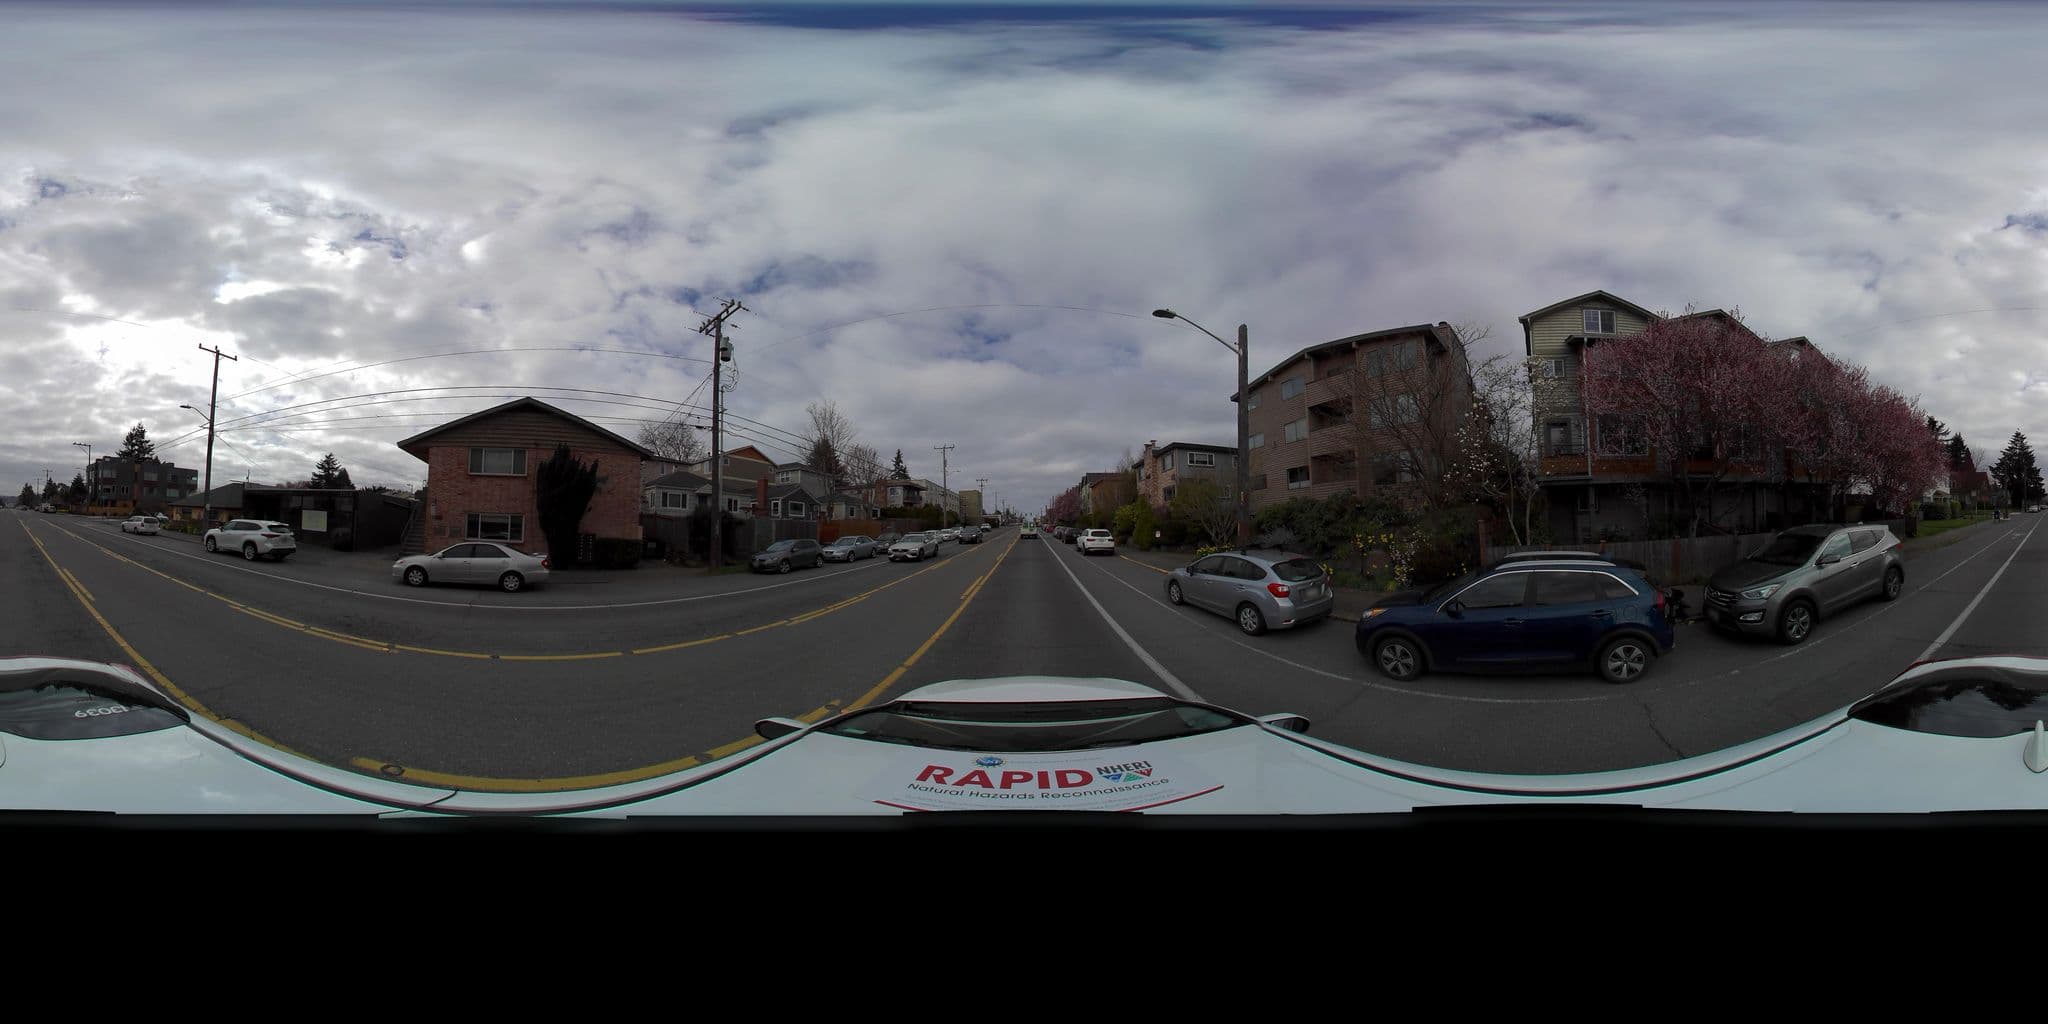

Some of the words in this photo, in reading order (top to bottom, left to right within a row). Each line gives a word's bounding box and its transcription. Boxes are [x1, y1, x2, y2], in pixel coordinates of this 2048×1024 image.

[74, 704, 129, 718] 13039
[1096, 760, 1152, 775] NHERI
[915, 764, 1094, 790] RAPID
[907, 783, 964, 797] Natural
[969, 790, 1035, 800] Hazards
[1041, 778, 1170, 799] Reconnaissance
